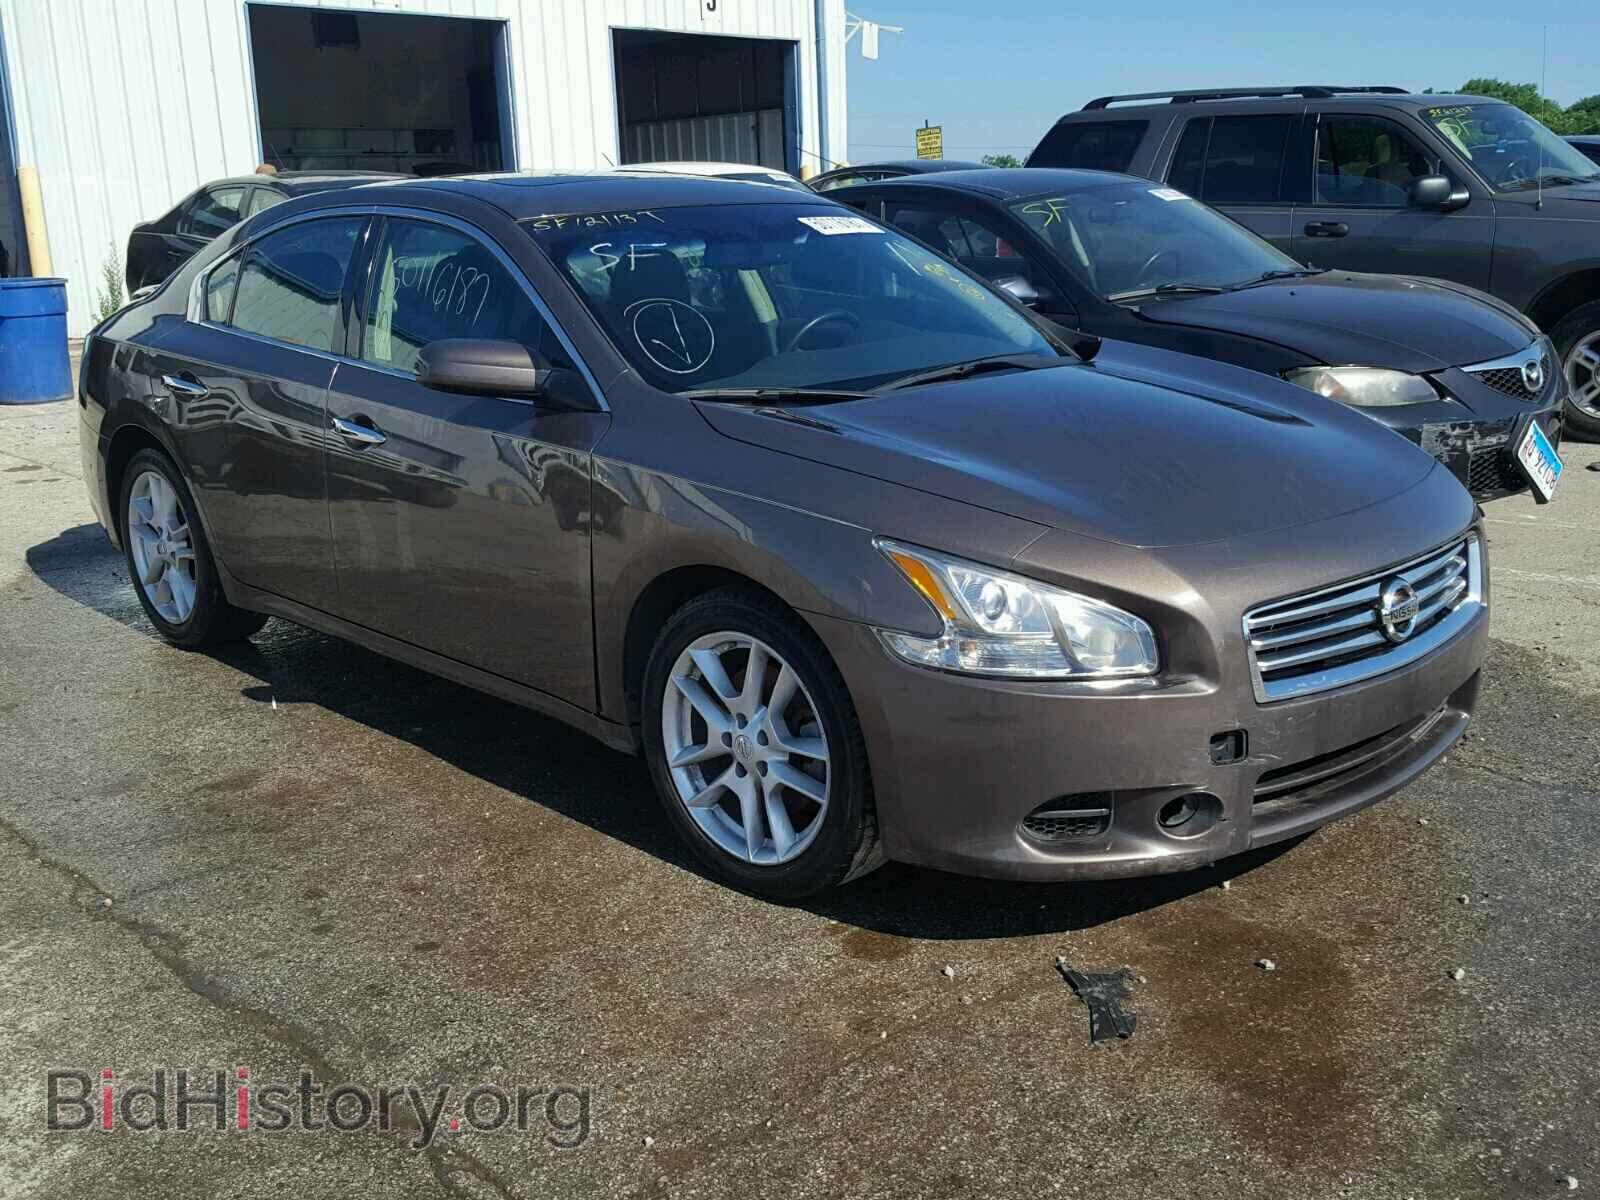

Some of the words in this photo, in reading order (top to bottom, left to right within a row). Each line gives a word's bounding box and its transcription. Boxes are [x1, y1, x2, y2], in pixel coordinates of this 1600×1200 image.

[533, 217, 567, 232] SF
[1022, 198, 1071, 227] SF
[589, 243, 667, 272] SF
